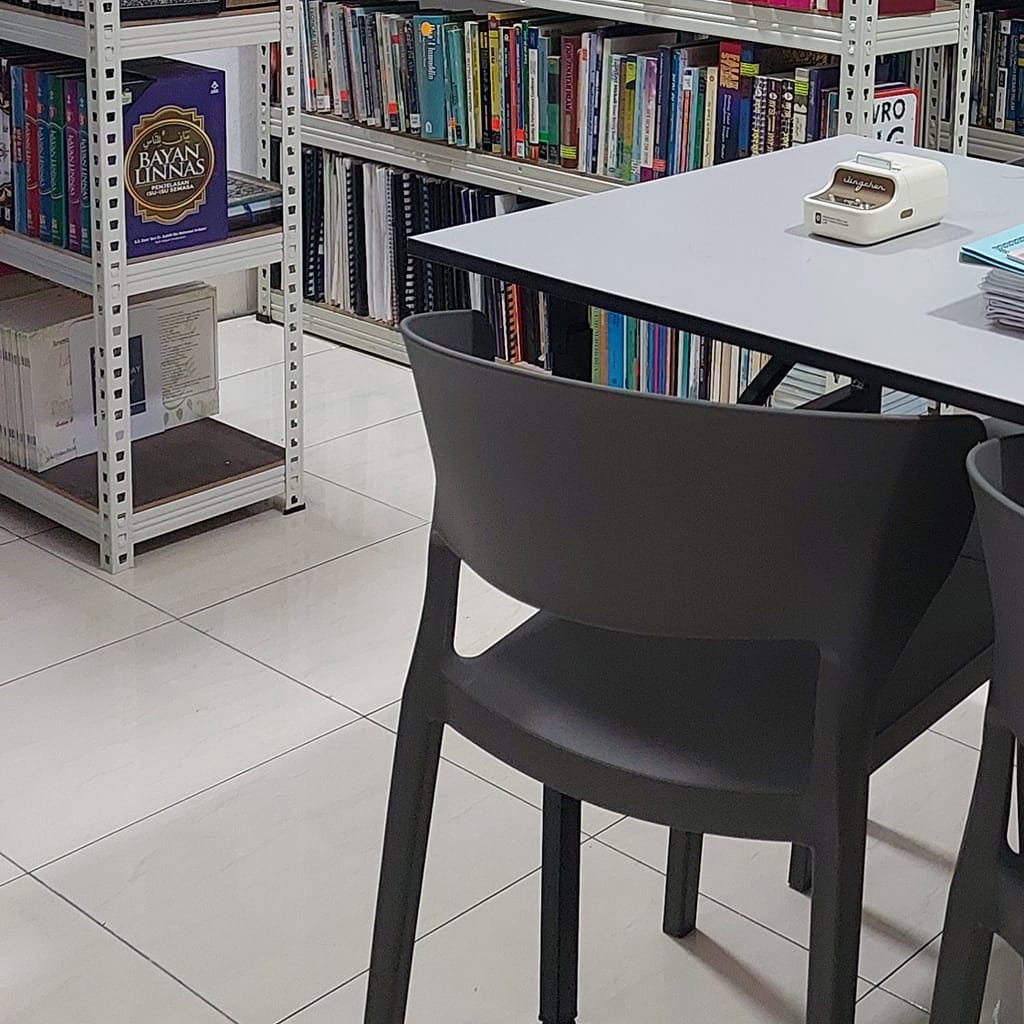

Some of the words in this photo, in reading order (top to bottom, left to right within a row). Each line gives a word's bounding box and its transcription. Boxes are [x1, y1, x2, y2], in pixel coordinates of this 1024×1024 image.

[138, 143, 201, 170] BAYAN
[135, 160, 206, 186] LINNAS
[151, 179, 190, 191] PENJELASAN
